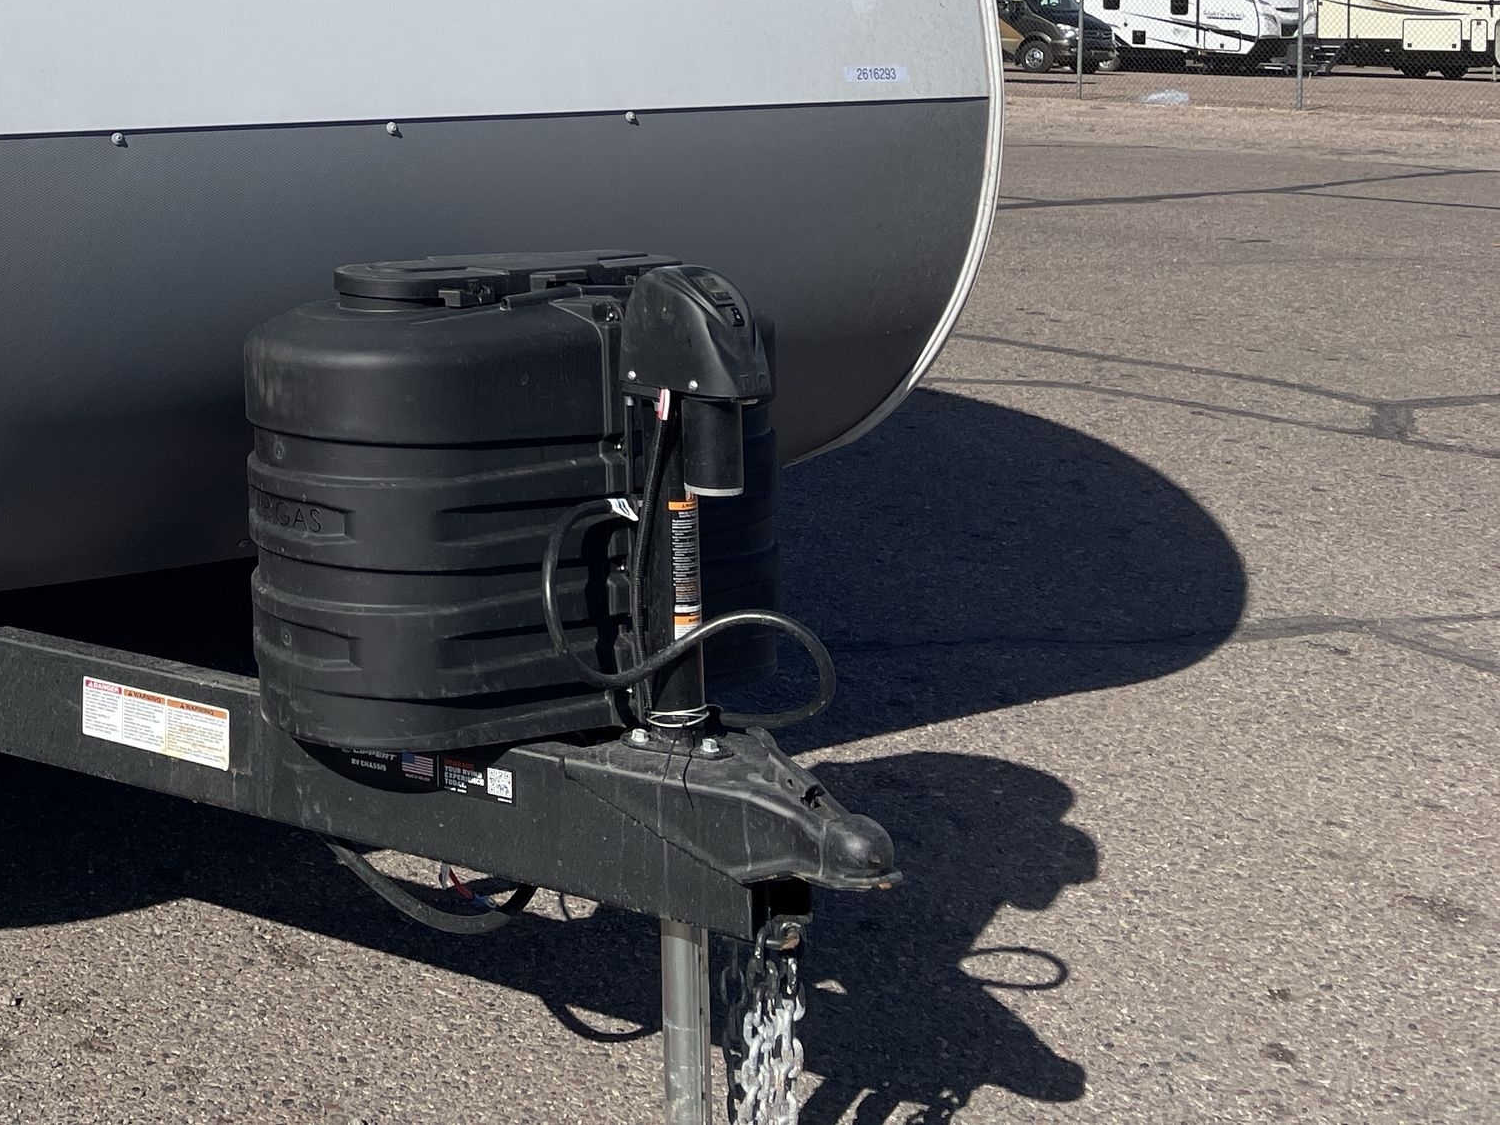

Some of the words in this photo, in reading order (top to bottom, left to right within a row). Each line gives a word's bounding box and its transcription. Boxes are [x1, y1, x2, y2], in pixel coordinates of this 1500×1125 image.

[856, 67, 897, 81] 2616293
[275, 500, 322, 533] GAS
[92, 681, 121, 694] DANGER
[133, 690, 162, 704] WARNING
[185, 703, 215, 717] WARNING
[360, 760, 387, 772] CHASSIS
[444, 765, 462, 775] YOUR
[444, 772, 485, 787] EXPERIENCE
